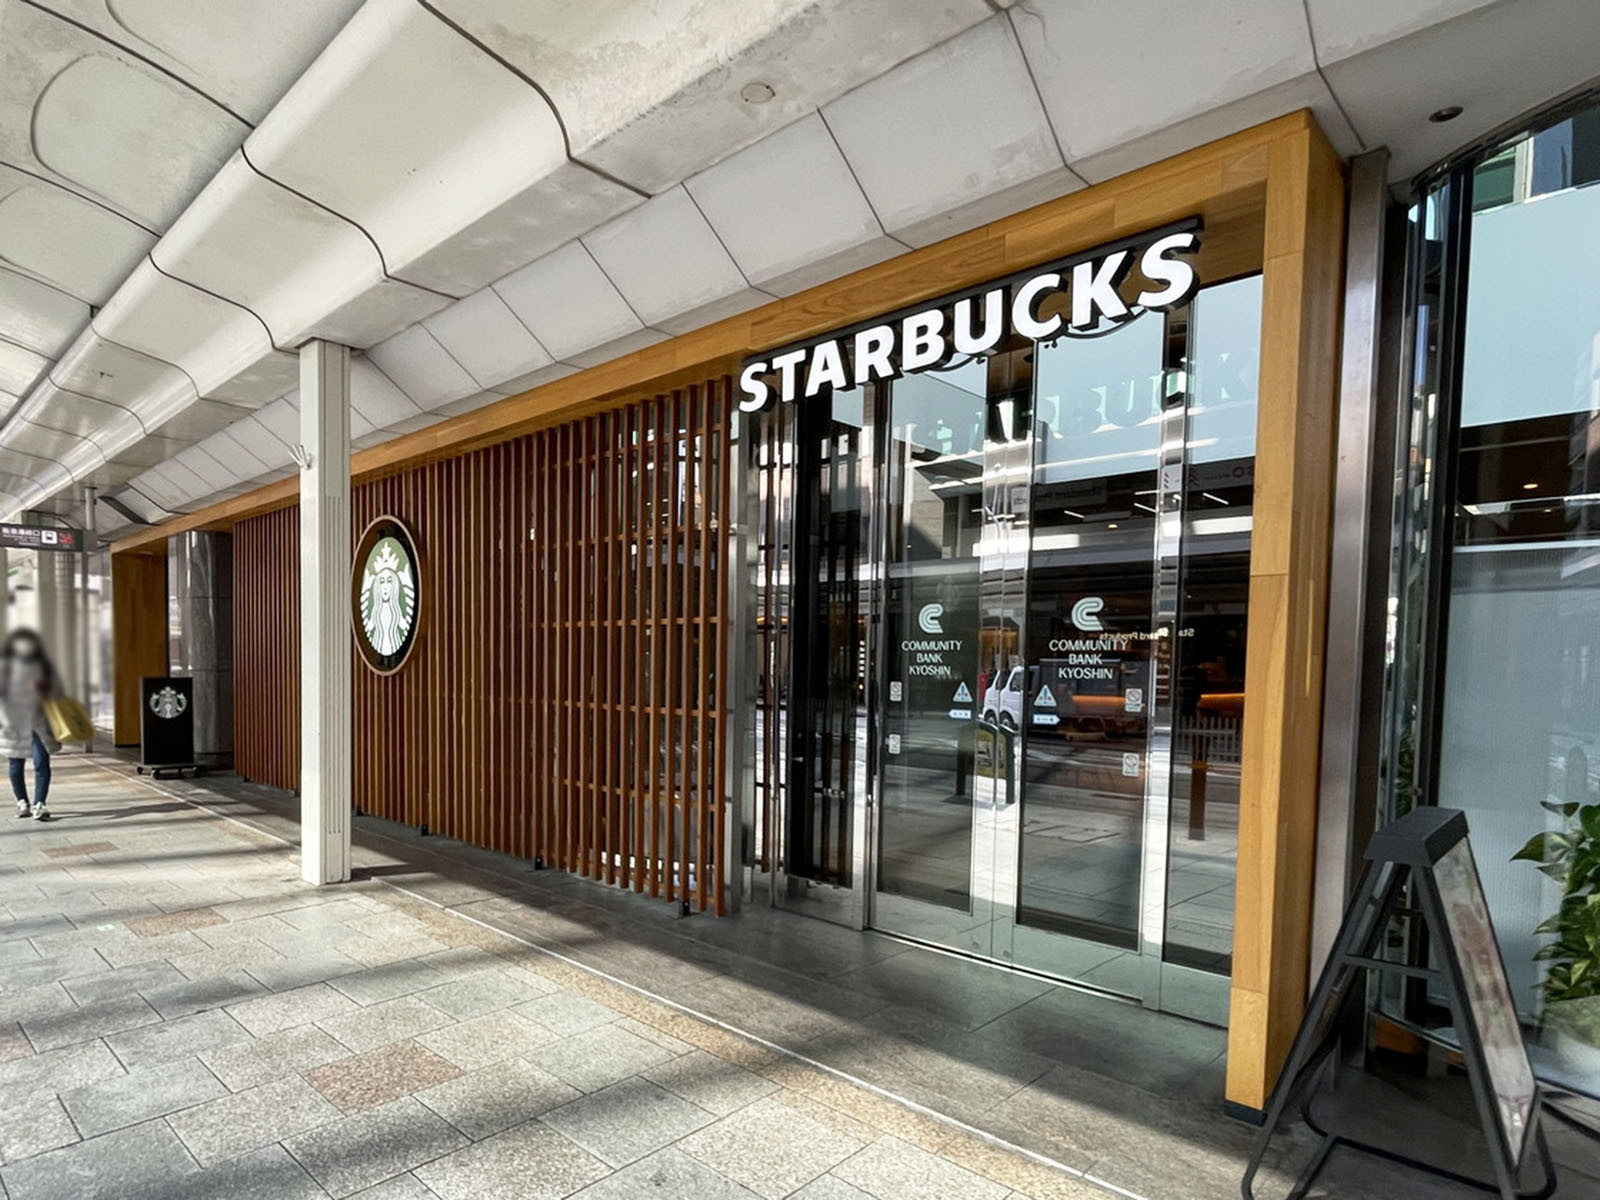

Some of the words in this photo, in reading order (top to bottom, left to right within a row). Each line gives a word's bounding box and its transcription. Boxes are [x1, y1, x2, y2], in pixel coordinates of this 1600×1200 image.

[738, 232, 1196, 413] STARBUCKS
[901, 640, 962, 651] COMMUNITY
[1048, 639, 1128, 652] COMMUNITY
[916, 652, 943, 663] BANK
[1068, 653, 1103, 665] BANK
[909, 664, 951, 676] KYOSHIN
[1058, 667, 1113, 680] KYOSHIN
